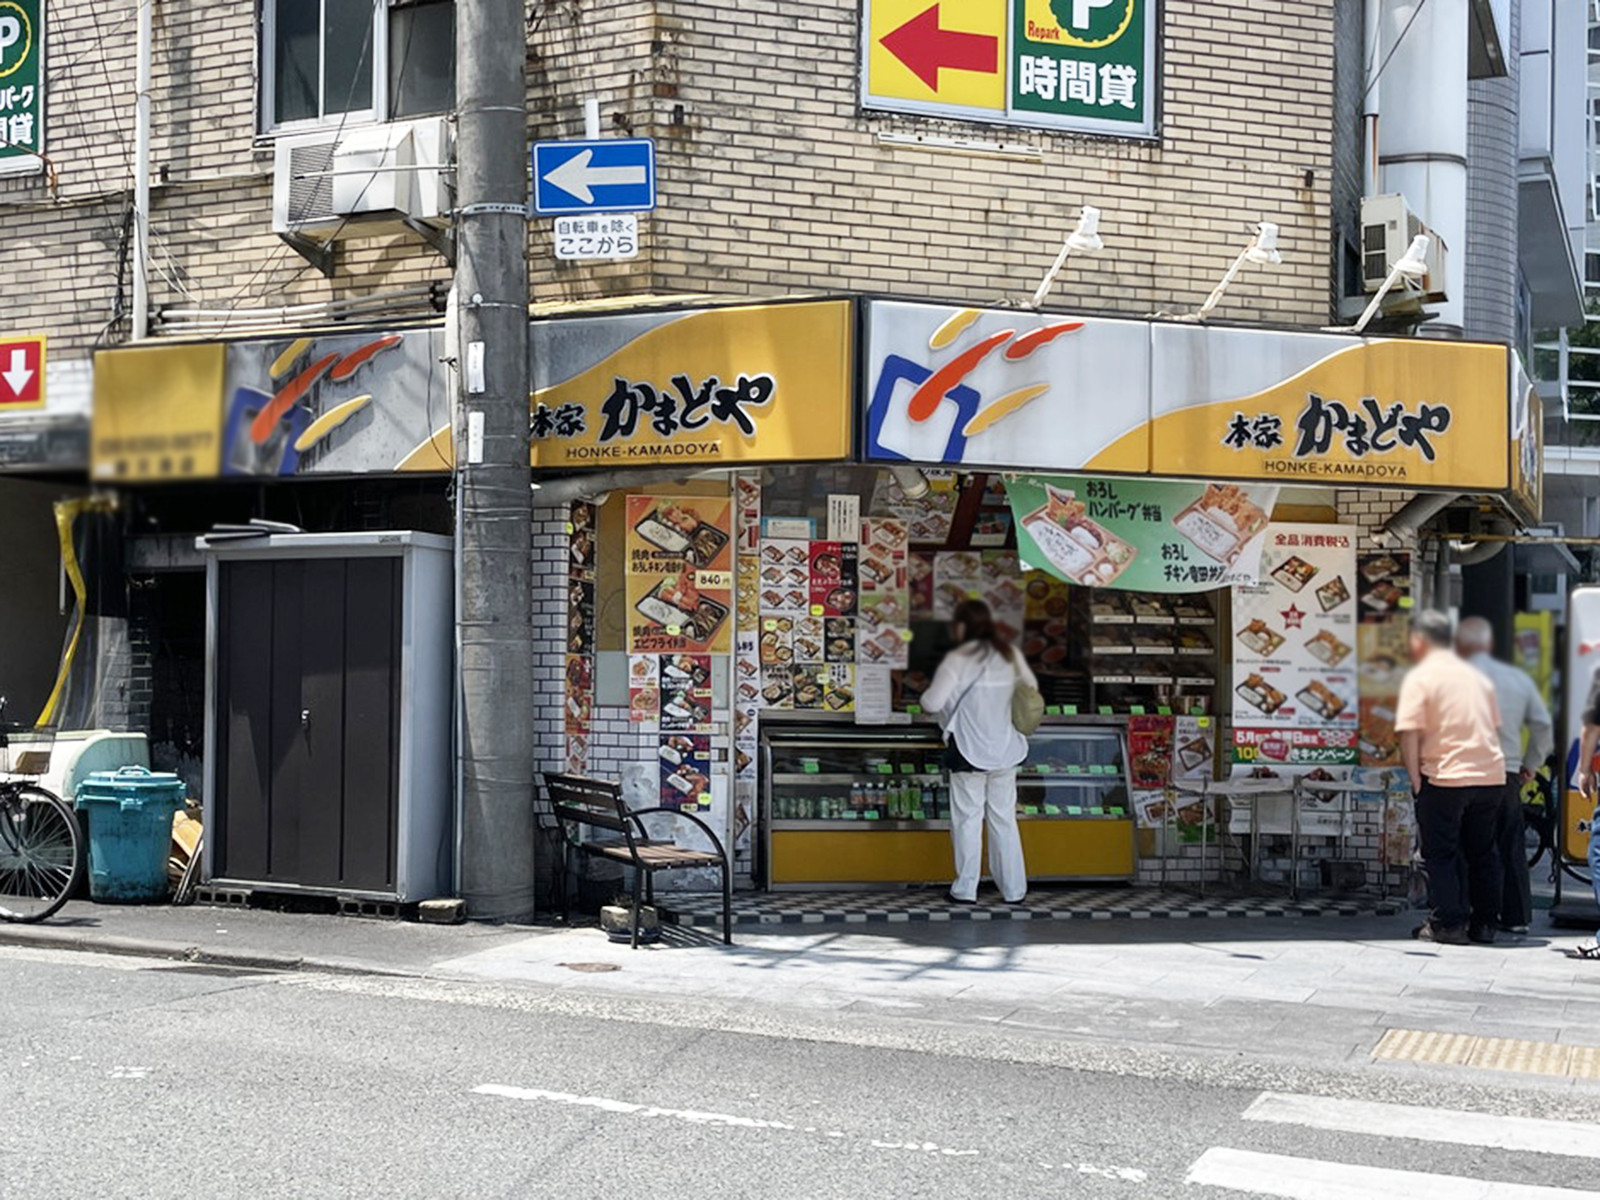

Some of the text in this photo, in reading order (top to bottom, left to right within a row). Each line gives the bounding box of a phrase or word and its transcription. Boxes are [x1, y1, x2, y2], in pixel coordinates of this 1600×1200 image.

[1028, 20, 1060, 40] Repark
[1019, 55, 1137, 109] 時間貸
[558, 220, 634, 235] 自転車を除く
[559, 236, 634, 255] ここから
[599, 373, 774, 442] かまどや
[1223, 392, 1451, 461] 本家 かまどや
[566, 442, 720, 459] HONKE-KAMADOYA
[1264, 459, 1407, 477] HONKE-KAMADOYA
[1086, 480, 1118, 500] おろし
[1161, 543, 1188, 561] おろし
